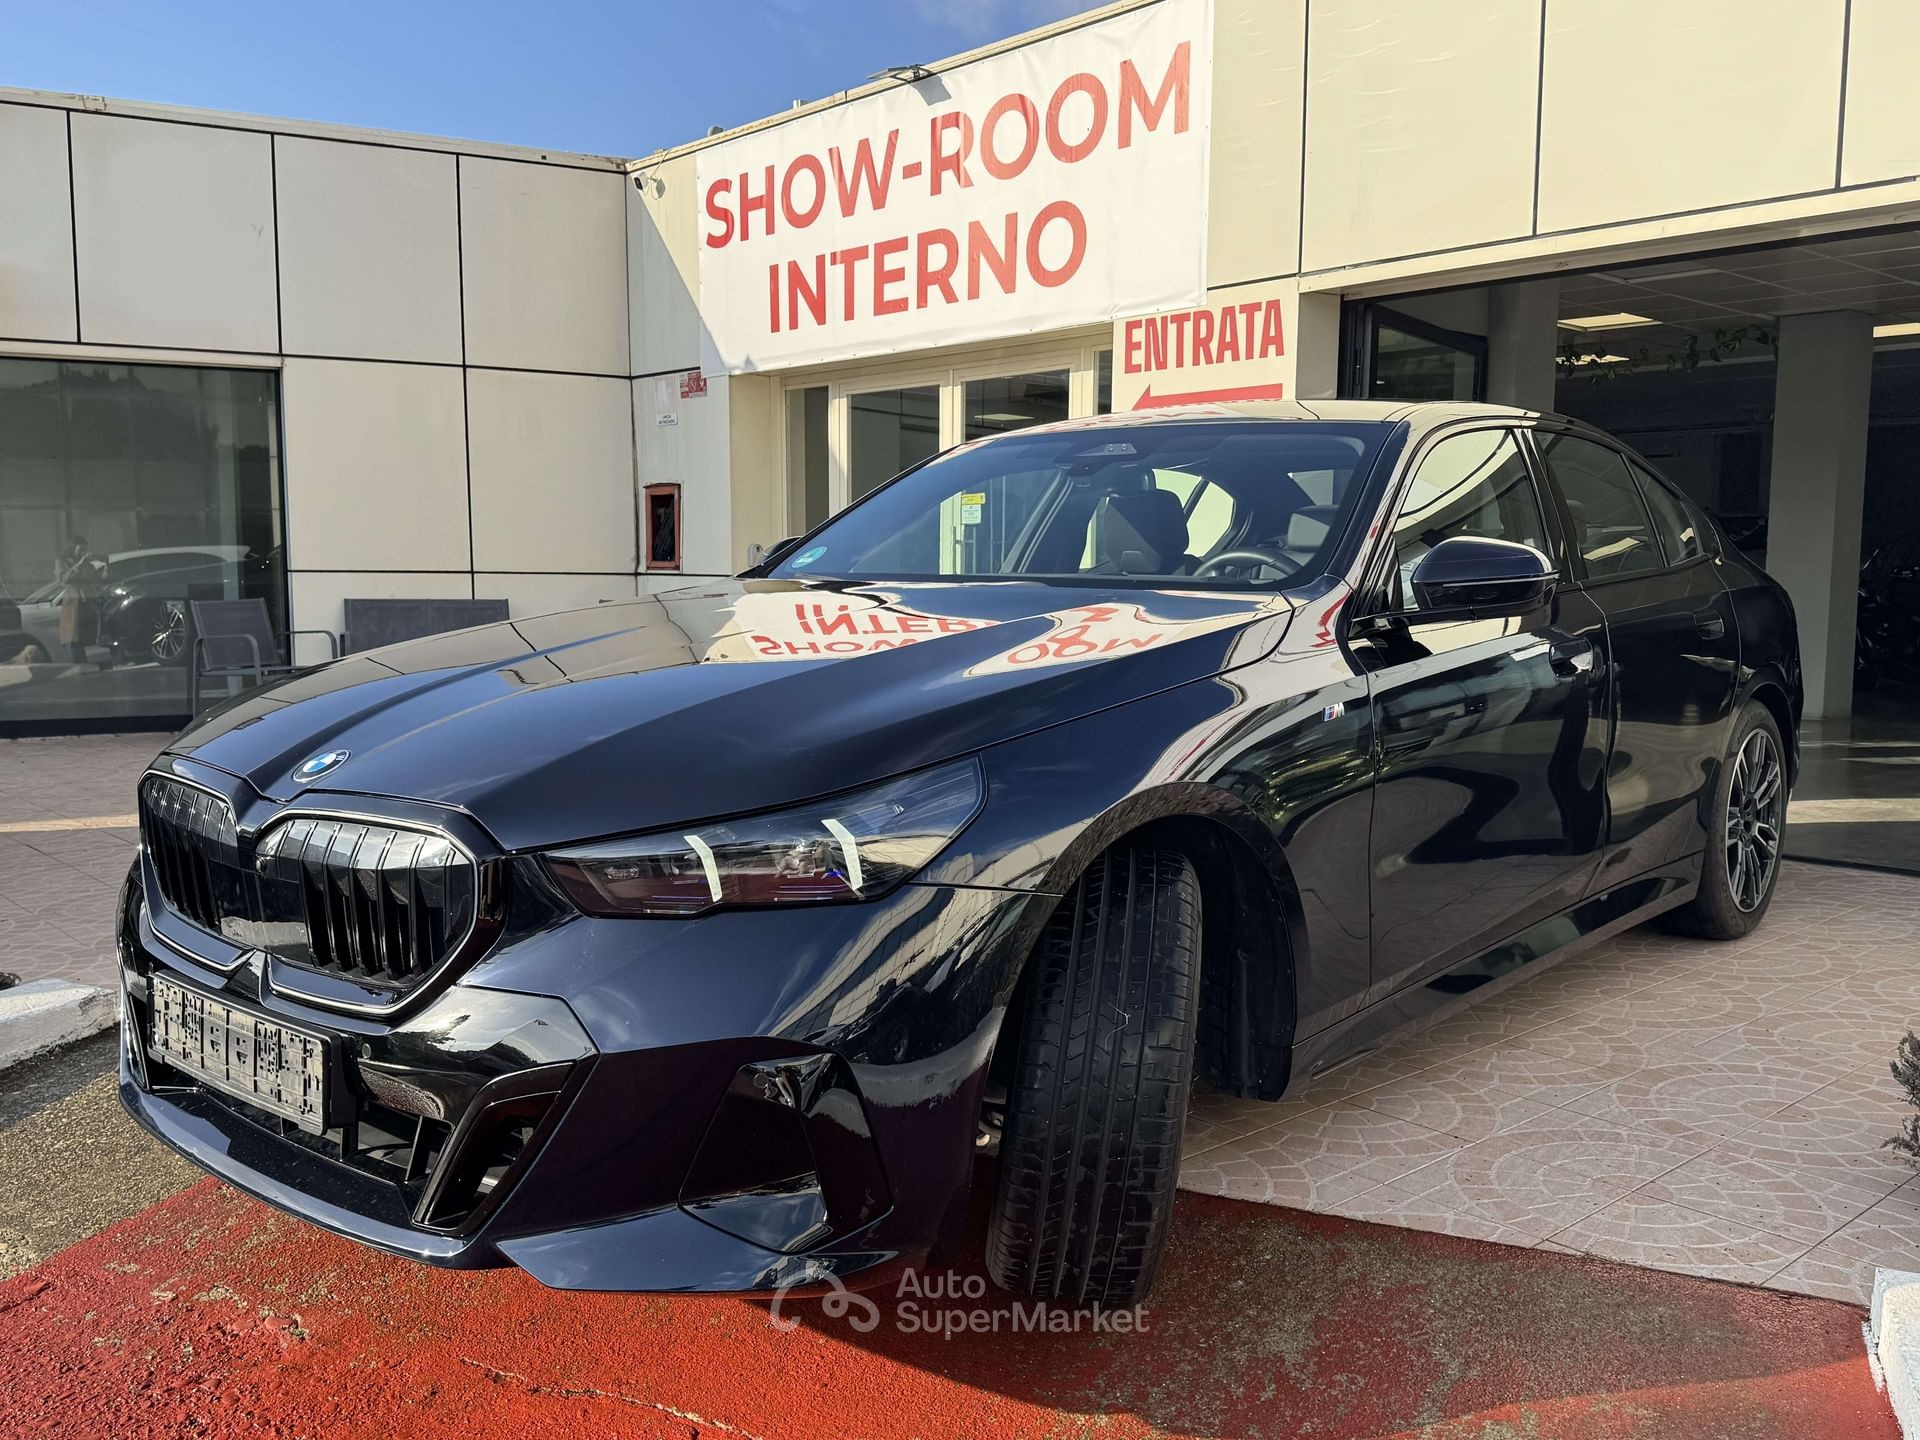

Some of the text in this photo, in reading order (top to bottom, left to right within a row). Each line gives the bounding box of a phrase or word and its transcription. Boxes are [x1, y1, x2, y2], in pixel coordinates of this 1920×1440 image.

[706, 40, 1191, 249] SHOW-ROOM
[769, 200, 1087, 334] INTERNO
[1124, 298, 1285, 375] ENTRATA
